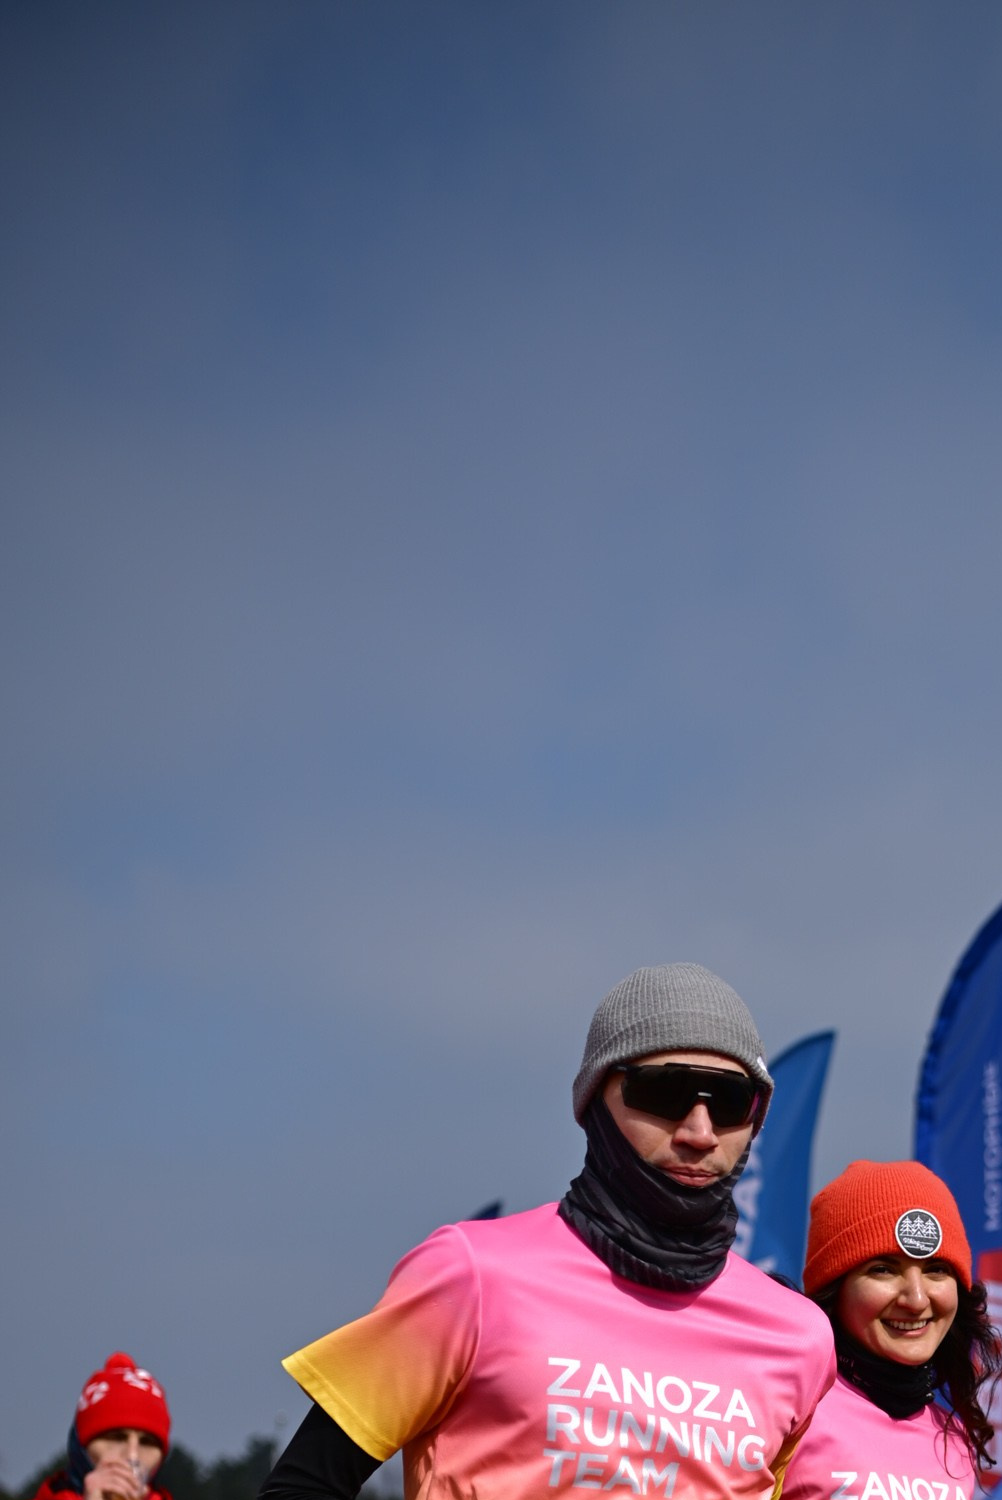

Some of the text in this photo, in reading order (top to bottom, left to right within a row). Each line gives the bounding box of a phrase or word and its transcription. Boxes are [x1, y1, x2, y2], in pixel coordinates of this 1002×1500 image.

[984, 1062, 1002, 1231] МОТОРНЫЕ
[546, 1357, 756, 1428] ZANOZA
[546, 1403, 766, 1472] RUNNING
[543, 1448, 681, 1499] TEAM
